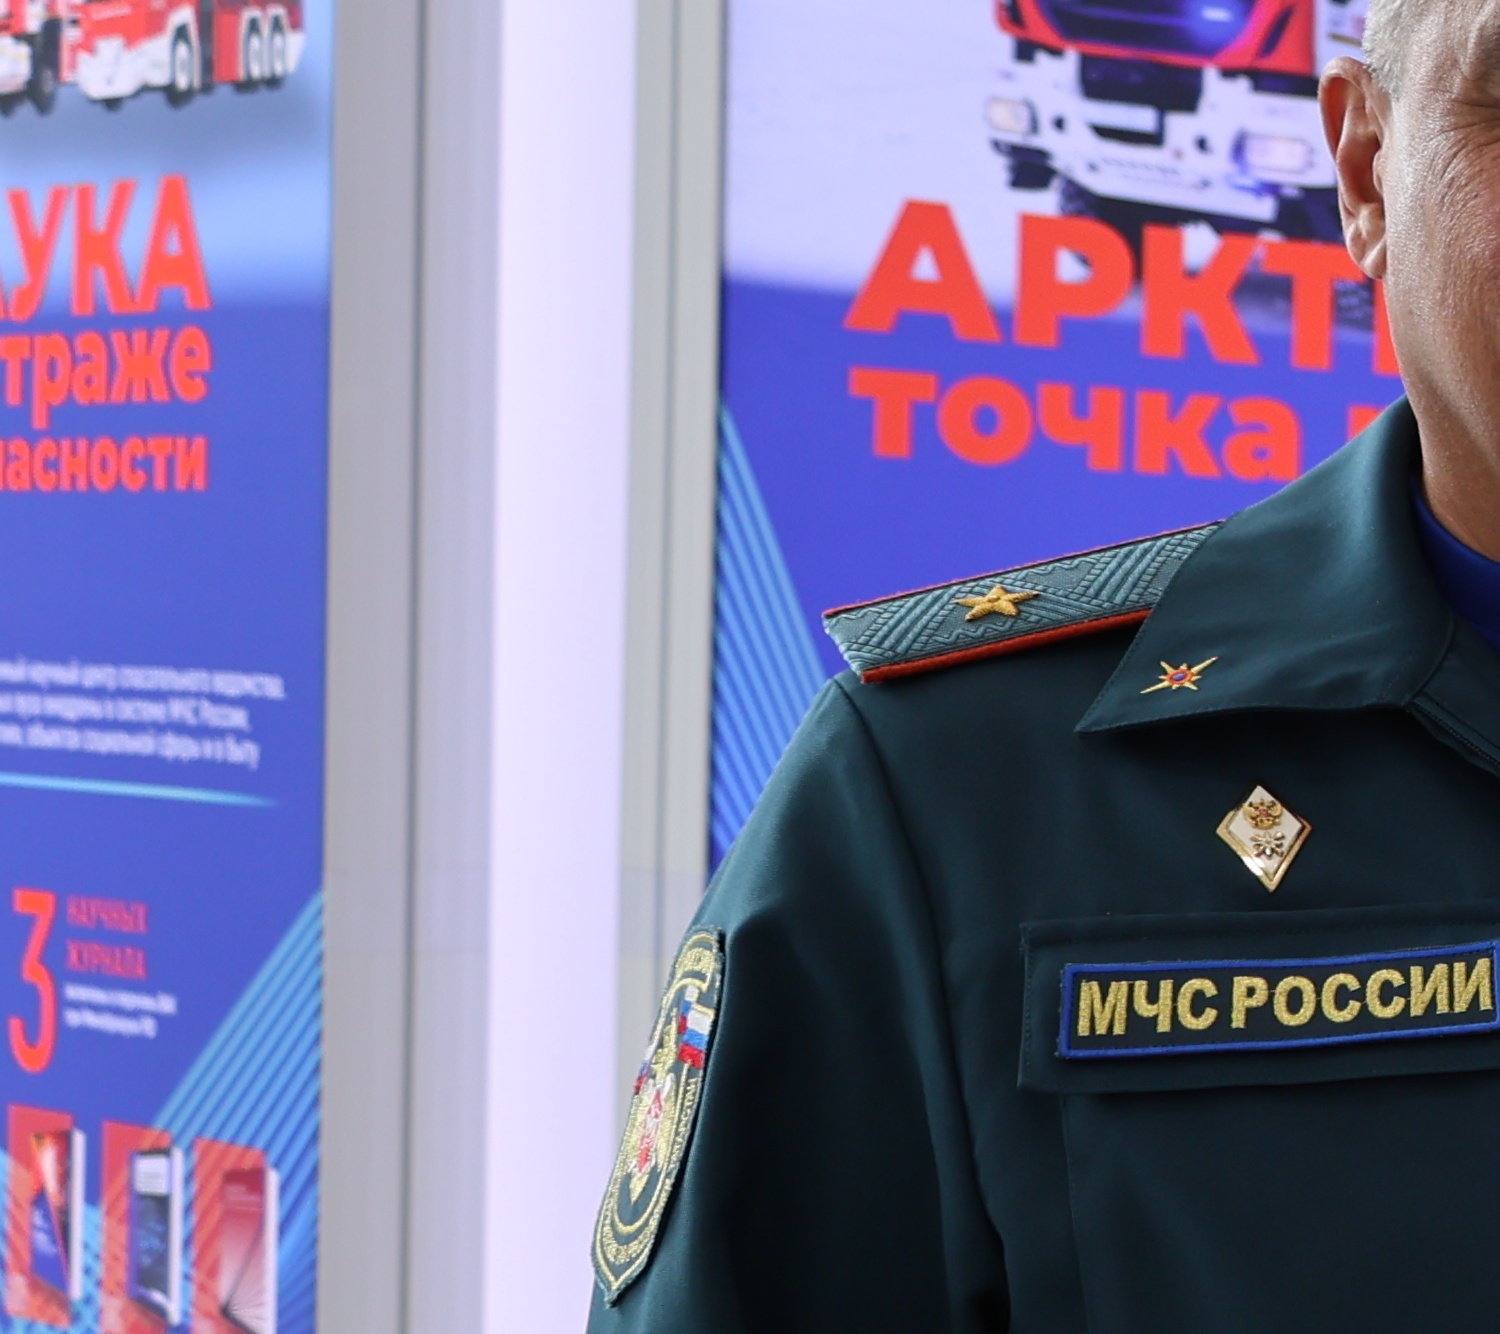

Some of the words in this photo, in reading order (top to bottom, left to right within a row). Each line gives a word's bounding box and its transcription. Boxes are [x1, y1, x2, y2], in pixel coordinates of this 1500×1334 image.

[0, 174, 212, 323] УКА
[844, 197, 1402, 378] АРКТ
[0, 325, 212, 430] траже
[848, 366, 1303, 482] точка
[0, 435, 208, 493] асности
[8, 887, 57, 1074] 3
[1077, 978, 1219, 1038] МЧС
[1230, 957, 1495, 1030] РОССИИ
